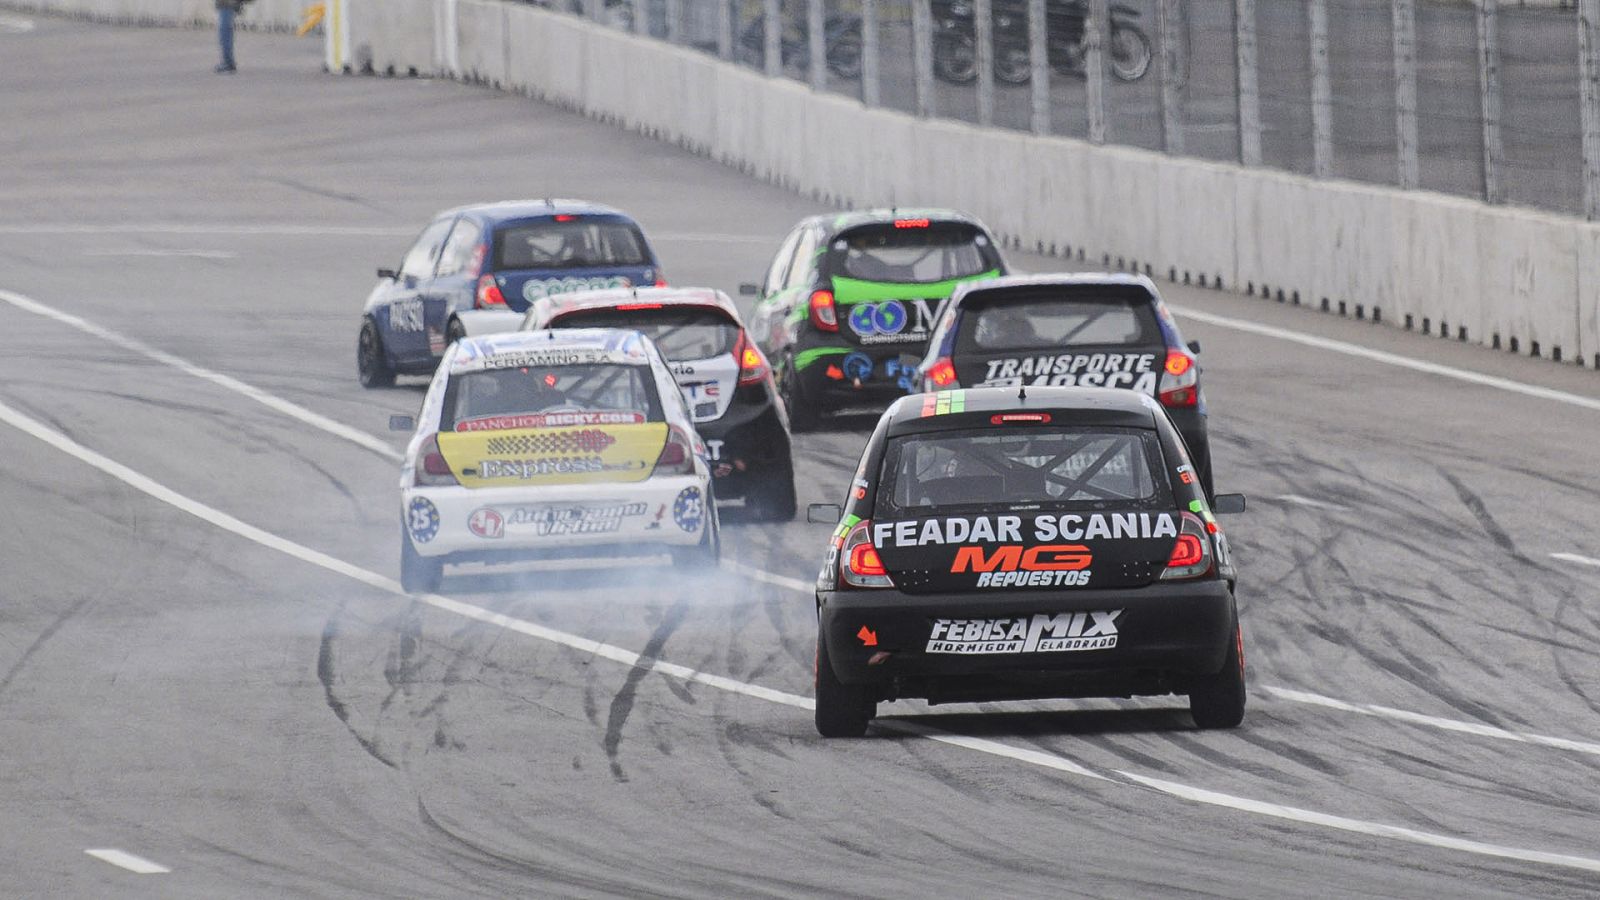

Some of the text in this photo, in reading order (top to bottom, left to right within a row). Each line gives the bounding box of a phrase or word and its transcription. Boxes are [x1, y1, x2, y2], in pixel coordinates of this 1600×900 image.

[483, 354, 580, 370] PERGAMINO
[986, 353, 1155, 380] TRANSPORTE
[480, 457, 604, 480] Express
[873, 511, 1178, 549] FEADAR SCANIA
[950, 545, 1093, 574] MG
[976, 570, 1092, 588] REPUESTOS
[1040, 637, 1117, 650] ELABORADO
